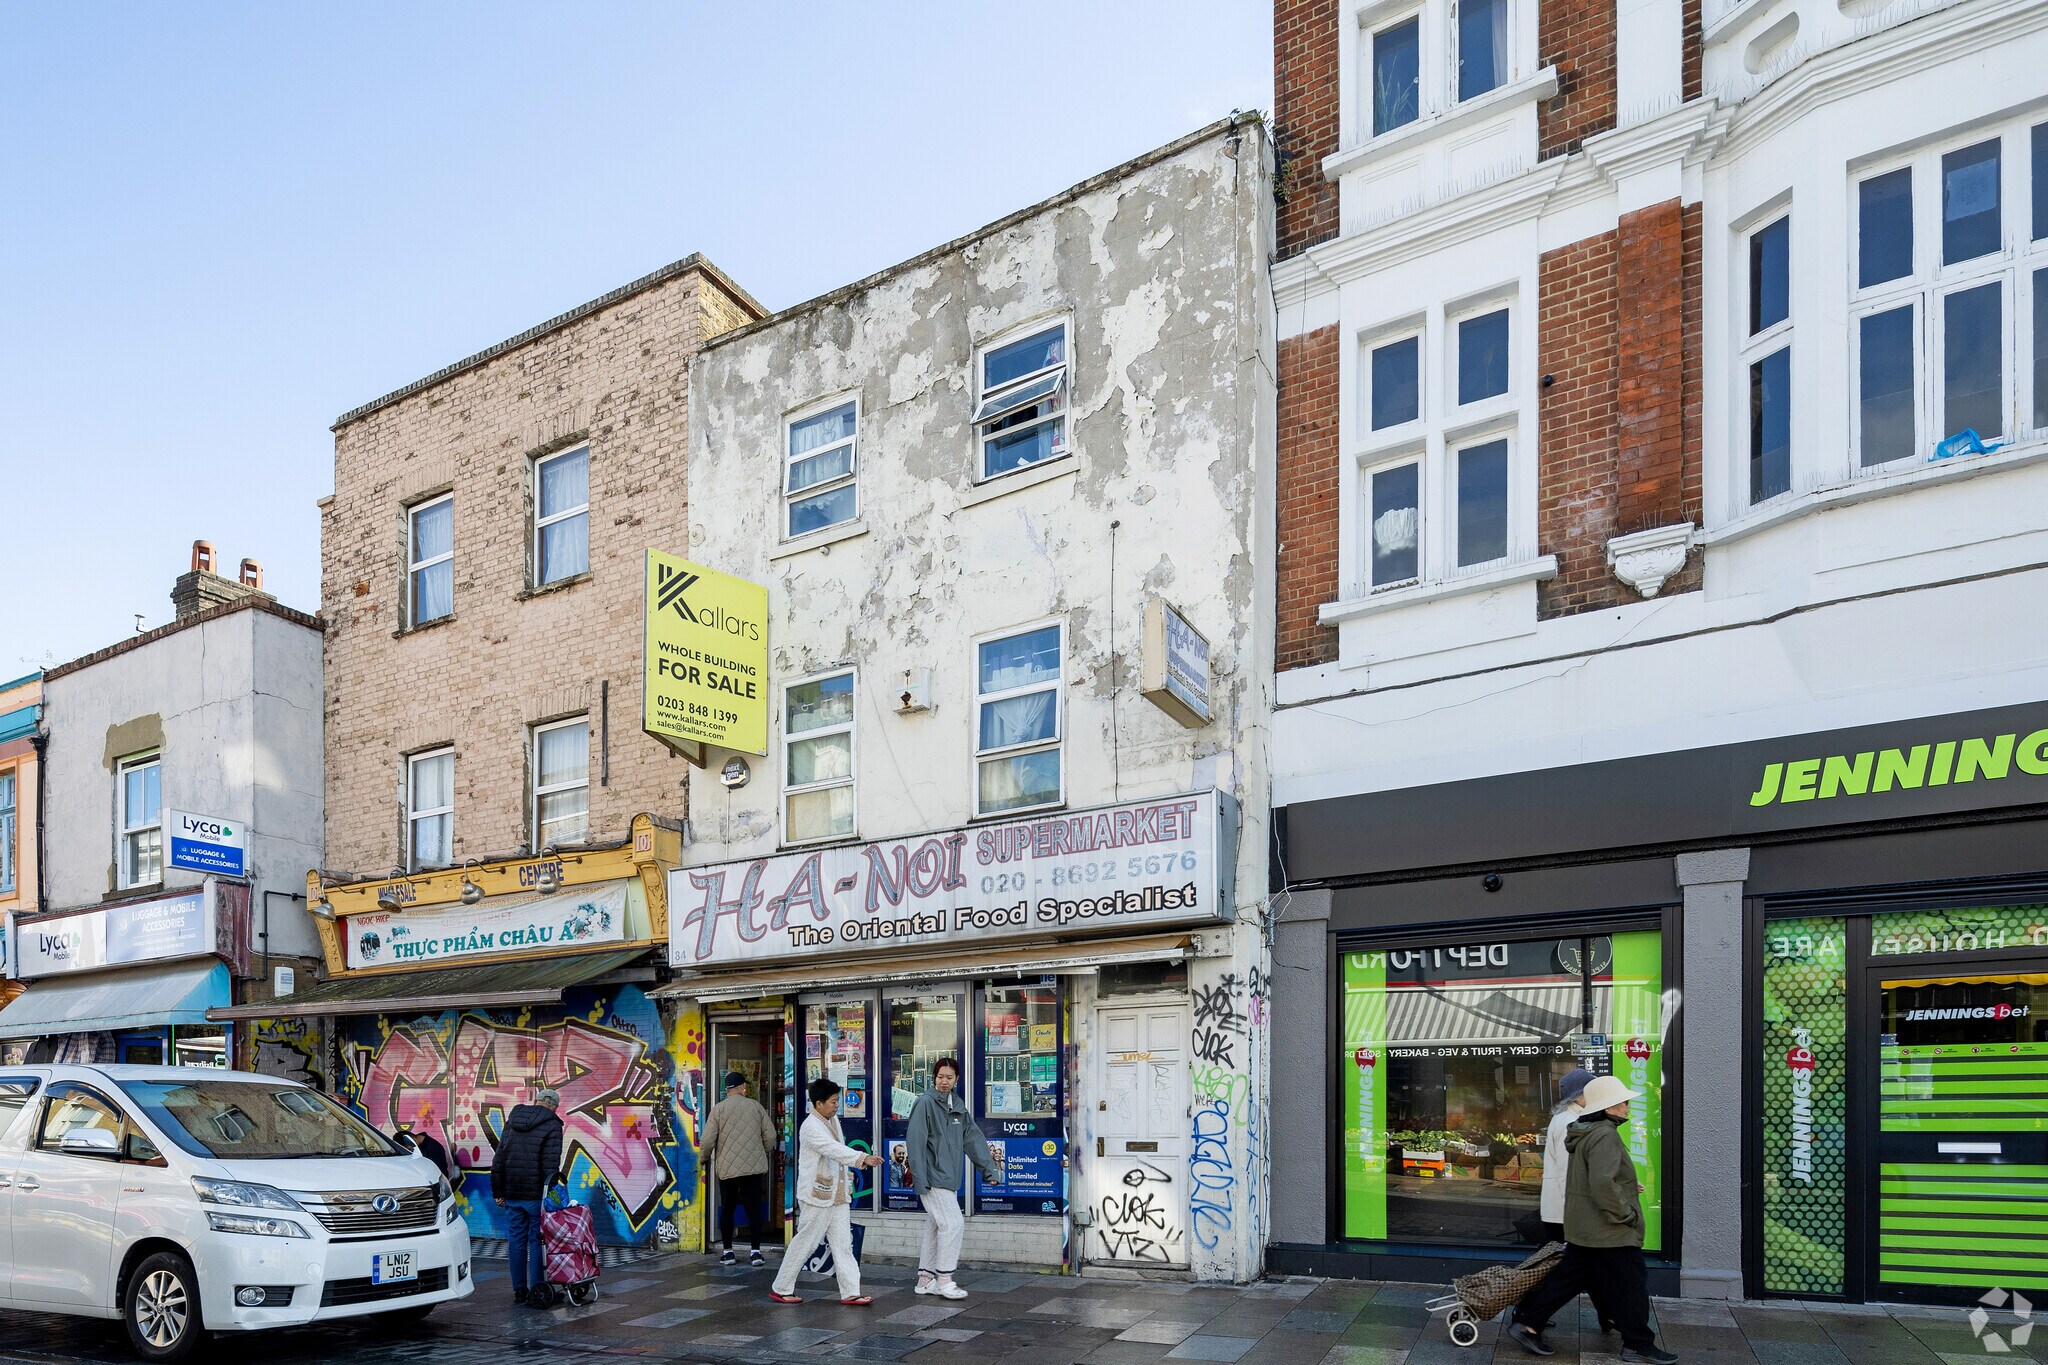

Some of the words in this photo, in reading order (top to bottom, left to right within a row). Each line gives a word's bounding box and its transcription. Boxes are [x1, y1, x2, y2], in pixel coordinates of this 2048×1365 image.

[658, 641, 701, 661] WHOLE
[704, 653, 756, 677] BUILDING
[658, 658, 701, 686] FOR
[707, 671, 757, 700] SALE
[657, 695, 685, 711] 0203
[688, 702, 709, 717] 848
[712, 709, 738, 724] 1399
[657, 710, 727, 732] www.kallars.com
[657, 719, 725, 741] sales@kallars.com
[183, 815, 221, 835] Lyca
[977, 800, 1198, 867] SUPERMARKET
[199, 833, 221, 842] Mobile
[176, 854, 200, 863] MOBILE
[200, 857, 240, 869] ACCESSORIES
[190, 847, 220, 858] LUGGAGE
[980, 871, 1027, 895] 020
[1051, 860, 1118, 888] 8692
[1127, 849, 1198, 879] 5676
[682, 832, 967, 961] HA-NOI
[132, 907, 163, 921] LUGGAGE
[163, 907, 169, 916] &
[169, 901, 196, 915] MOBILE
[787, 924, 834, 948] The
[840, 909, 947, 942] Oriental
[955, 900, 1028, 931] Food
[1037, 881, 1198, 926] Specialist
[142, 917, 185, 933] ACCESSORIES
[40, 933, 70, 956] Lyca
[393, 938, 438, 960] THỰC
[443, 926, 494, 953] PHẨM
[499, 924, 553, 946] CHÂU
[53, 951, 70, 960] Mobile
[1003, 1121, 1027, 1133] Lyca
[387, 1254, 411, 1266] LN12
[389, 1265, 409, 1278] JSU
